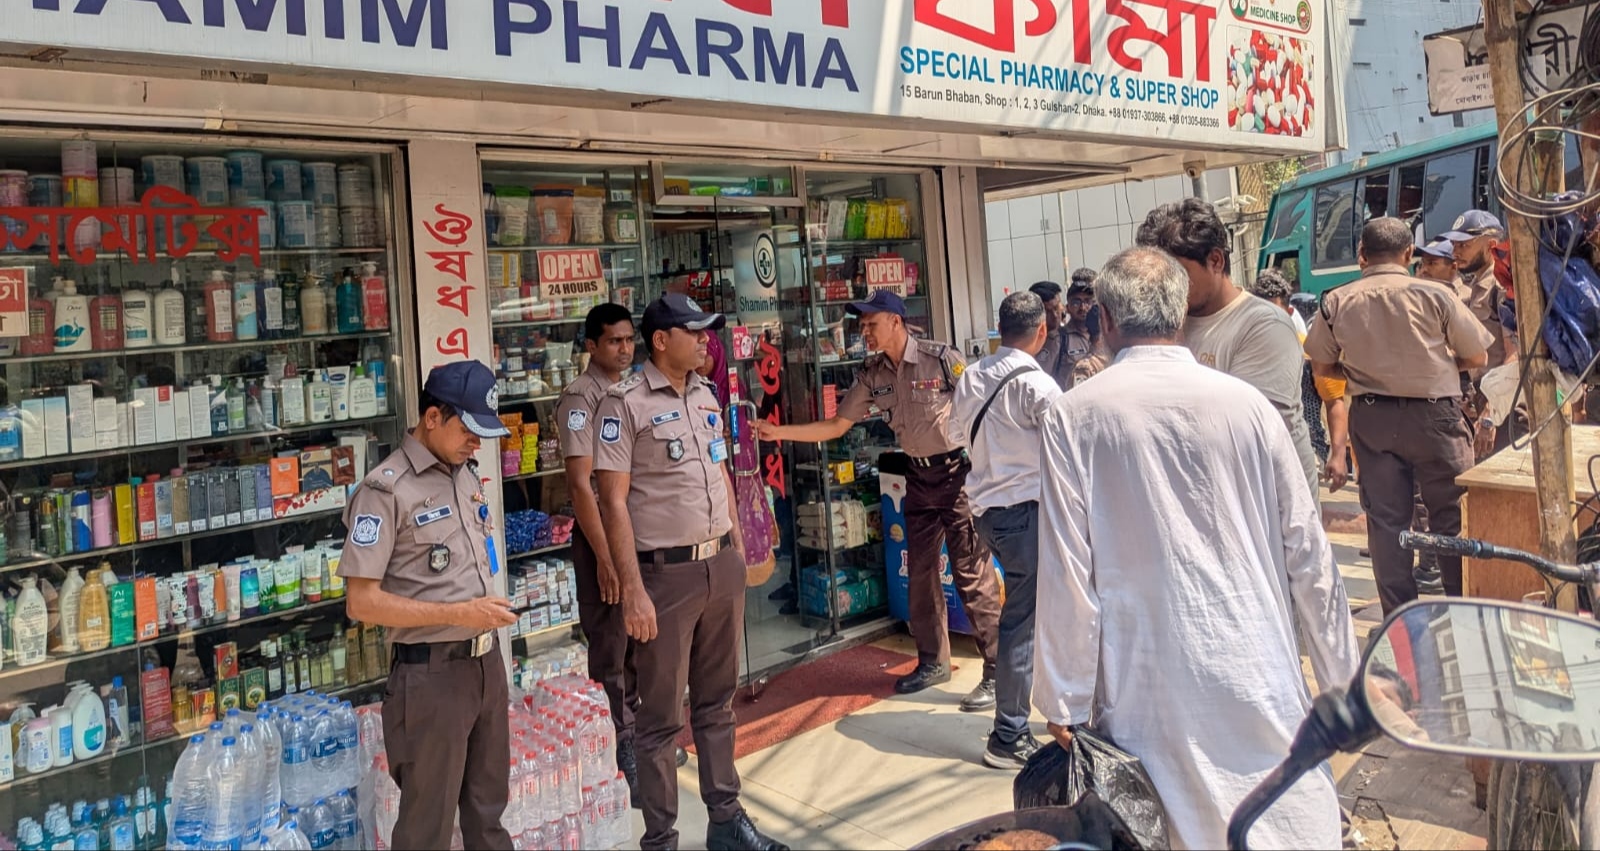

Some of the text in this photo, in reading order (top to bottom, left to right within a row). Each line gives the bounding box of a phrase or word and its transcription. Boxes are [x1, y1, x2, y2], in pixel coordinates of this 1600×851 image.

[1250, 6, 1280, 22] MEDICINE
[1280, 13, 1296, 24] SHOP
[493, 0, 859, 93] PHARMA
[900, 46, 1219, 109] SPECIAL PHARMACY & SUPER SHOP
[900, 84, 912, 97] 15
[915, 86, 943, 101] Barun
[946, 89, 983, 106] Bhaban,
[985, 93, 1007, 109] Shop
[1015, 97, 1022, 110] 1,
[1024, 98, 1032, 110] 2,
[1033, 98, 1039, 110] 3
[1040, 99, 1081, 116] Gulshan-2,
[1109, 107, 1121, 118] +88
[1169, 114, 1179, 124] +88
[0, 185, 268, 268] সমেটিক্স
[543, 253, 598, 280] OPEN
[869, 262, 902, 283] OPEN
[548, 281, 598, 295] 24 HOURS
[740, 296, 769, 312] Shamim
